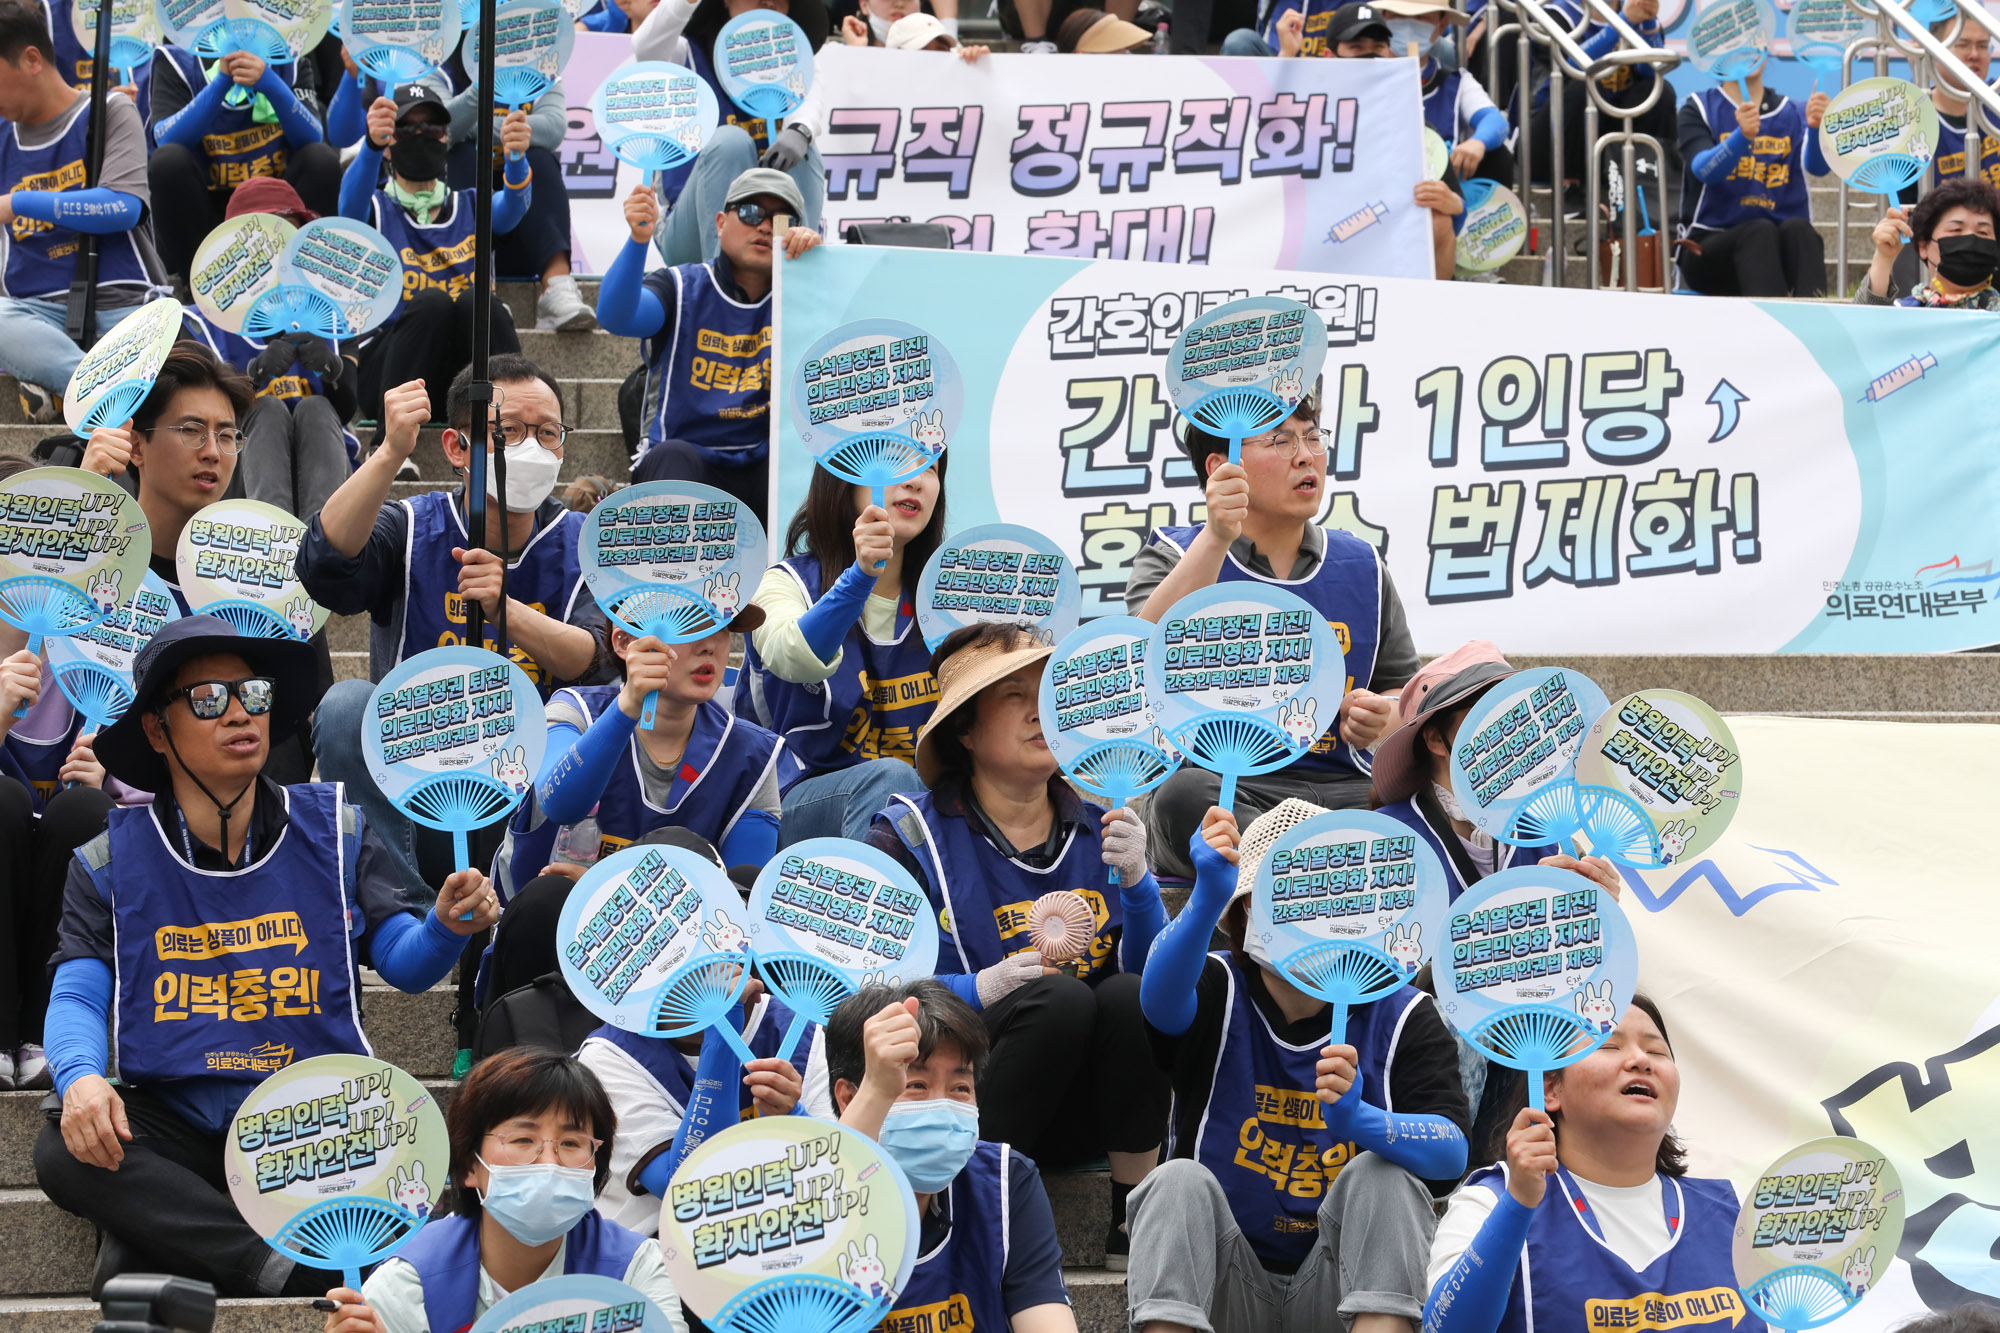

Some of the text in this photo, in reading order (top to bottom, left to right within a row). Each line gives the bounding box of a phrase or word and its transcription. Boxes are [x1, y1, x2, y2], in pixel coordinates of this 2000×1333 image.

[606, 77, 697, 95] 윤석열정권 퇴진!
[606, 92, 697, 110] 의료민영화 저지!
[606, 106, 697, 122] 간호인력인권법 제정!
[1011, 93, 1359, 198] 정규직화!
[250, 232, 269, 258] UP!
[298, 240, 360, 273] 의료민영화
[359, 263, 388, 286] 저지!
[308, 225, 397, 270] 윤석열정권 퇴진!
[291, 255, 357, 289] 간호인력인권법
[355, 279, 378, 299] 제정!
[701, 334, 729, 352] 의료는
[1183, 327, 1304, 364] 의료민영화 저지!
[1185, 310, 1306, 347] 윤석열정권 퇴진!
[804, 335, 927, 382] 윤석열정권 퇴진!
[1182, 345, 1300, 381] 간호인력인권법 제정!
[808, 359, 931, 405] 의료민영화 저지!
[810, 382, 933, 424] 간호인력인권법 제정!
[1416, 348, 1684, 470] 1인당
[75, 518, 118, 537] UP!
[599, 502, 737, 527] 윤석열정권 퇴진!
[598, 523, 736, 547] 의료민영화 저지!
[1426, 468, 1761, 605] 법제화!
[598, 544, 735, 567] 간호인력인권법 제정!
[940, 548, 1063, 575] 윤석열정권 퇴진!
[935, 570, 1058, 597] 의료민영화 저지!
[1823, 581, 1923, 591] 민주노총 공공운수노조
[136, 590, 171, 616] 퇴진!
[932, 593, 1054, 616] 간호인력인권법 제정!
[1826, 588, 1987, 620] 의료연대본부
[1165, 610, 1311, 644] 윤석열정권 퇴진!
[1052, 644, 1127, 685] 윤석열정권
[1165, 640, 1262, 669] 의료민영화
[1265, 638, 1311, 662] 저지!
[378, 665, 510, 718] 윤석열정권 퇴진!
[1055, 672, 1131, 710] 의료민영화
[1165, 667, 1272, 693] 간호인력인권법
[1274, 665, 1310, 685] 제정!
[381, 690, 512, 743] 의료민영화 저지!
[1058, 691, 1142, 731] 간호인력인권법
[1458, 672, 1567, 771] 윤석열정권 퇴진!
[384, 716, 514, 765] 간호인력인권법 제정!
[1468, 693, 1576, 790] 의료민영화 저지!
[1475, 713, 1584, 808] 간호인력인권법 제정!
[1684, 760, 1720, 790] UP!
[1272, 836, 1415, 875] 윤석열정권 퇴진!
[780, 855, 922, 916] 윤석열정권 퇴진!
[1272, 864, 1415, 901] 의료민영화 저지!
[565, 849, 667, 970] 윤석열정권 퇴진!
[771, 880, 915, 940] 의료민영화 저지!
[1273, 890, 1414, 925] 간호인력인권법 제정!
[1451, 890, 1597, 942] 윤석열정권 퇴진!
[163, 918, 302, 952] 의료는 상품이 아니다
[585, 868, 687, 990] 의료민영화 저지!
[602, 888, 703, 1006] 간호인력인권법 제정!
[766, 903, 906, 960] 간호인력인권법 제정!
[1453, 918, 1600, 969] 의료민영화 저지!
[1456, 946, 1602, 993] 간호인력인권법 제정!
[154, 967, 322, 1022] 인력충원!
[206, 1057, 282, 1072] 의료연대본부
[348, 1101, 394, 1134] UP!
[1284, 1097, 1314, 1119] 상품이
[792, 1168, 844, 1203] UP!
[1836, 1189, 1876, 1212] UP!
[592, 1301, 645, 1333] 퇴진!
[1594, 1293, 1735, 1326] 의료는 상품이 아니다
